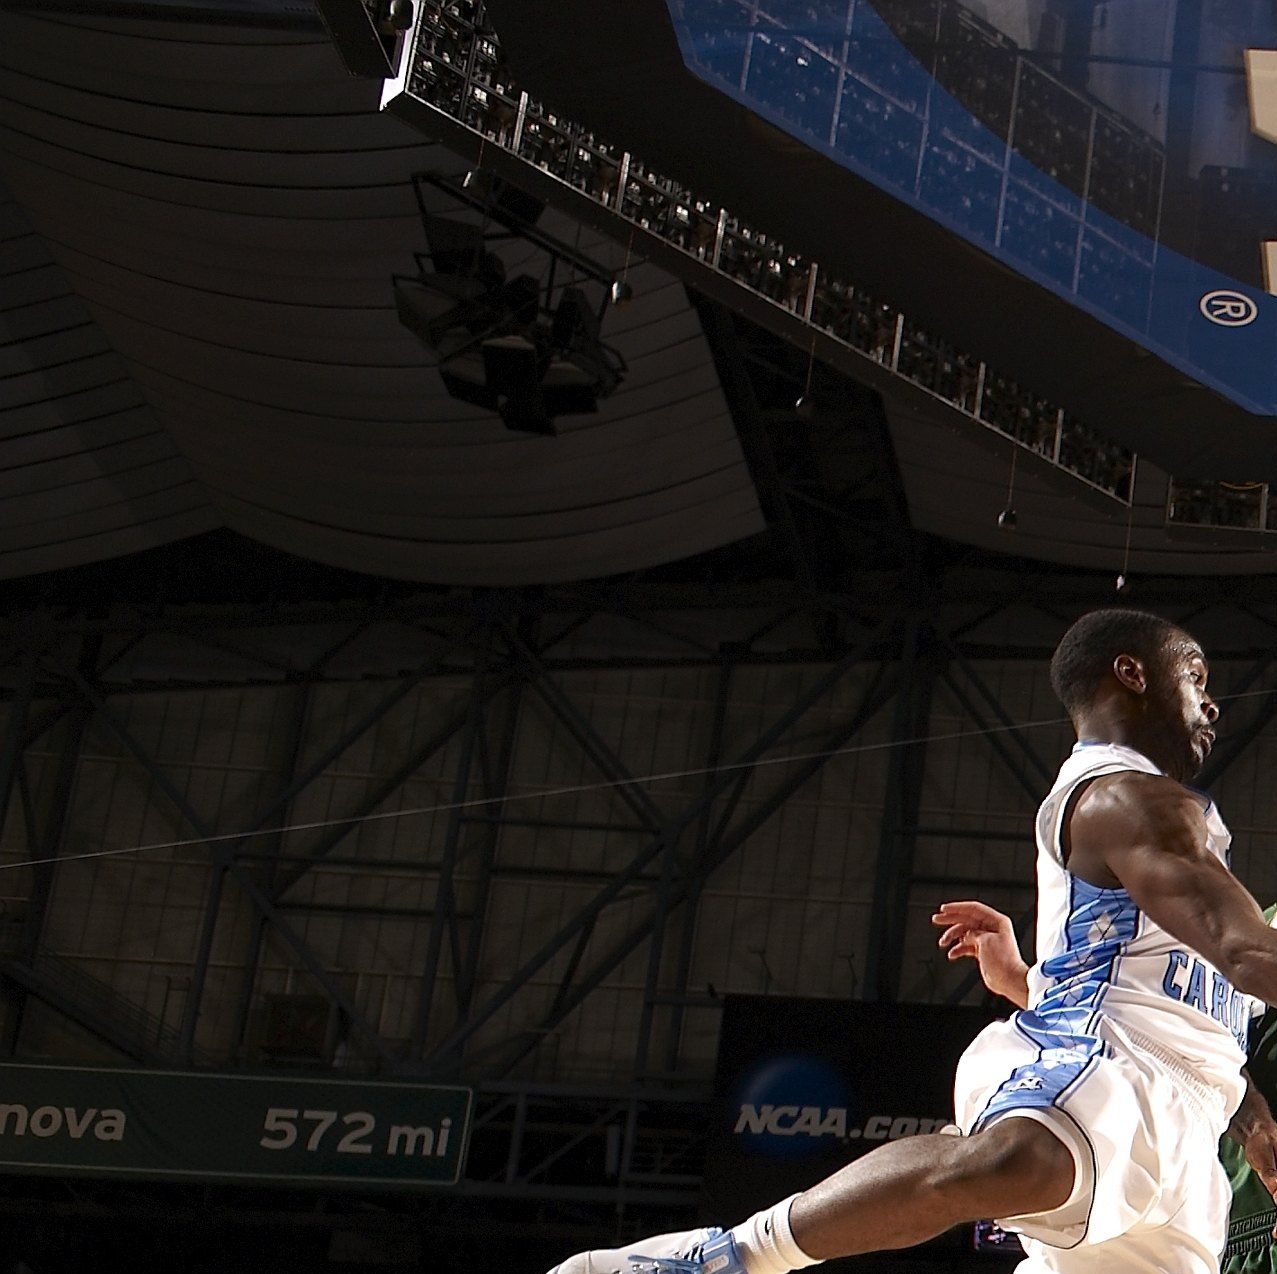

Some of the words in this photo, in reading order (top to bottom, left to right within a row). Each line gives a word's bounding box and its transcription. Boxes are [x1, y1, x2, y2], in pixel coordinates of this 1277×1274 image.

[0, 1102, 126, 1142] nova
[260, 1107, 376, 1155] 572
[386, 1116, 453, 1158] mi
